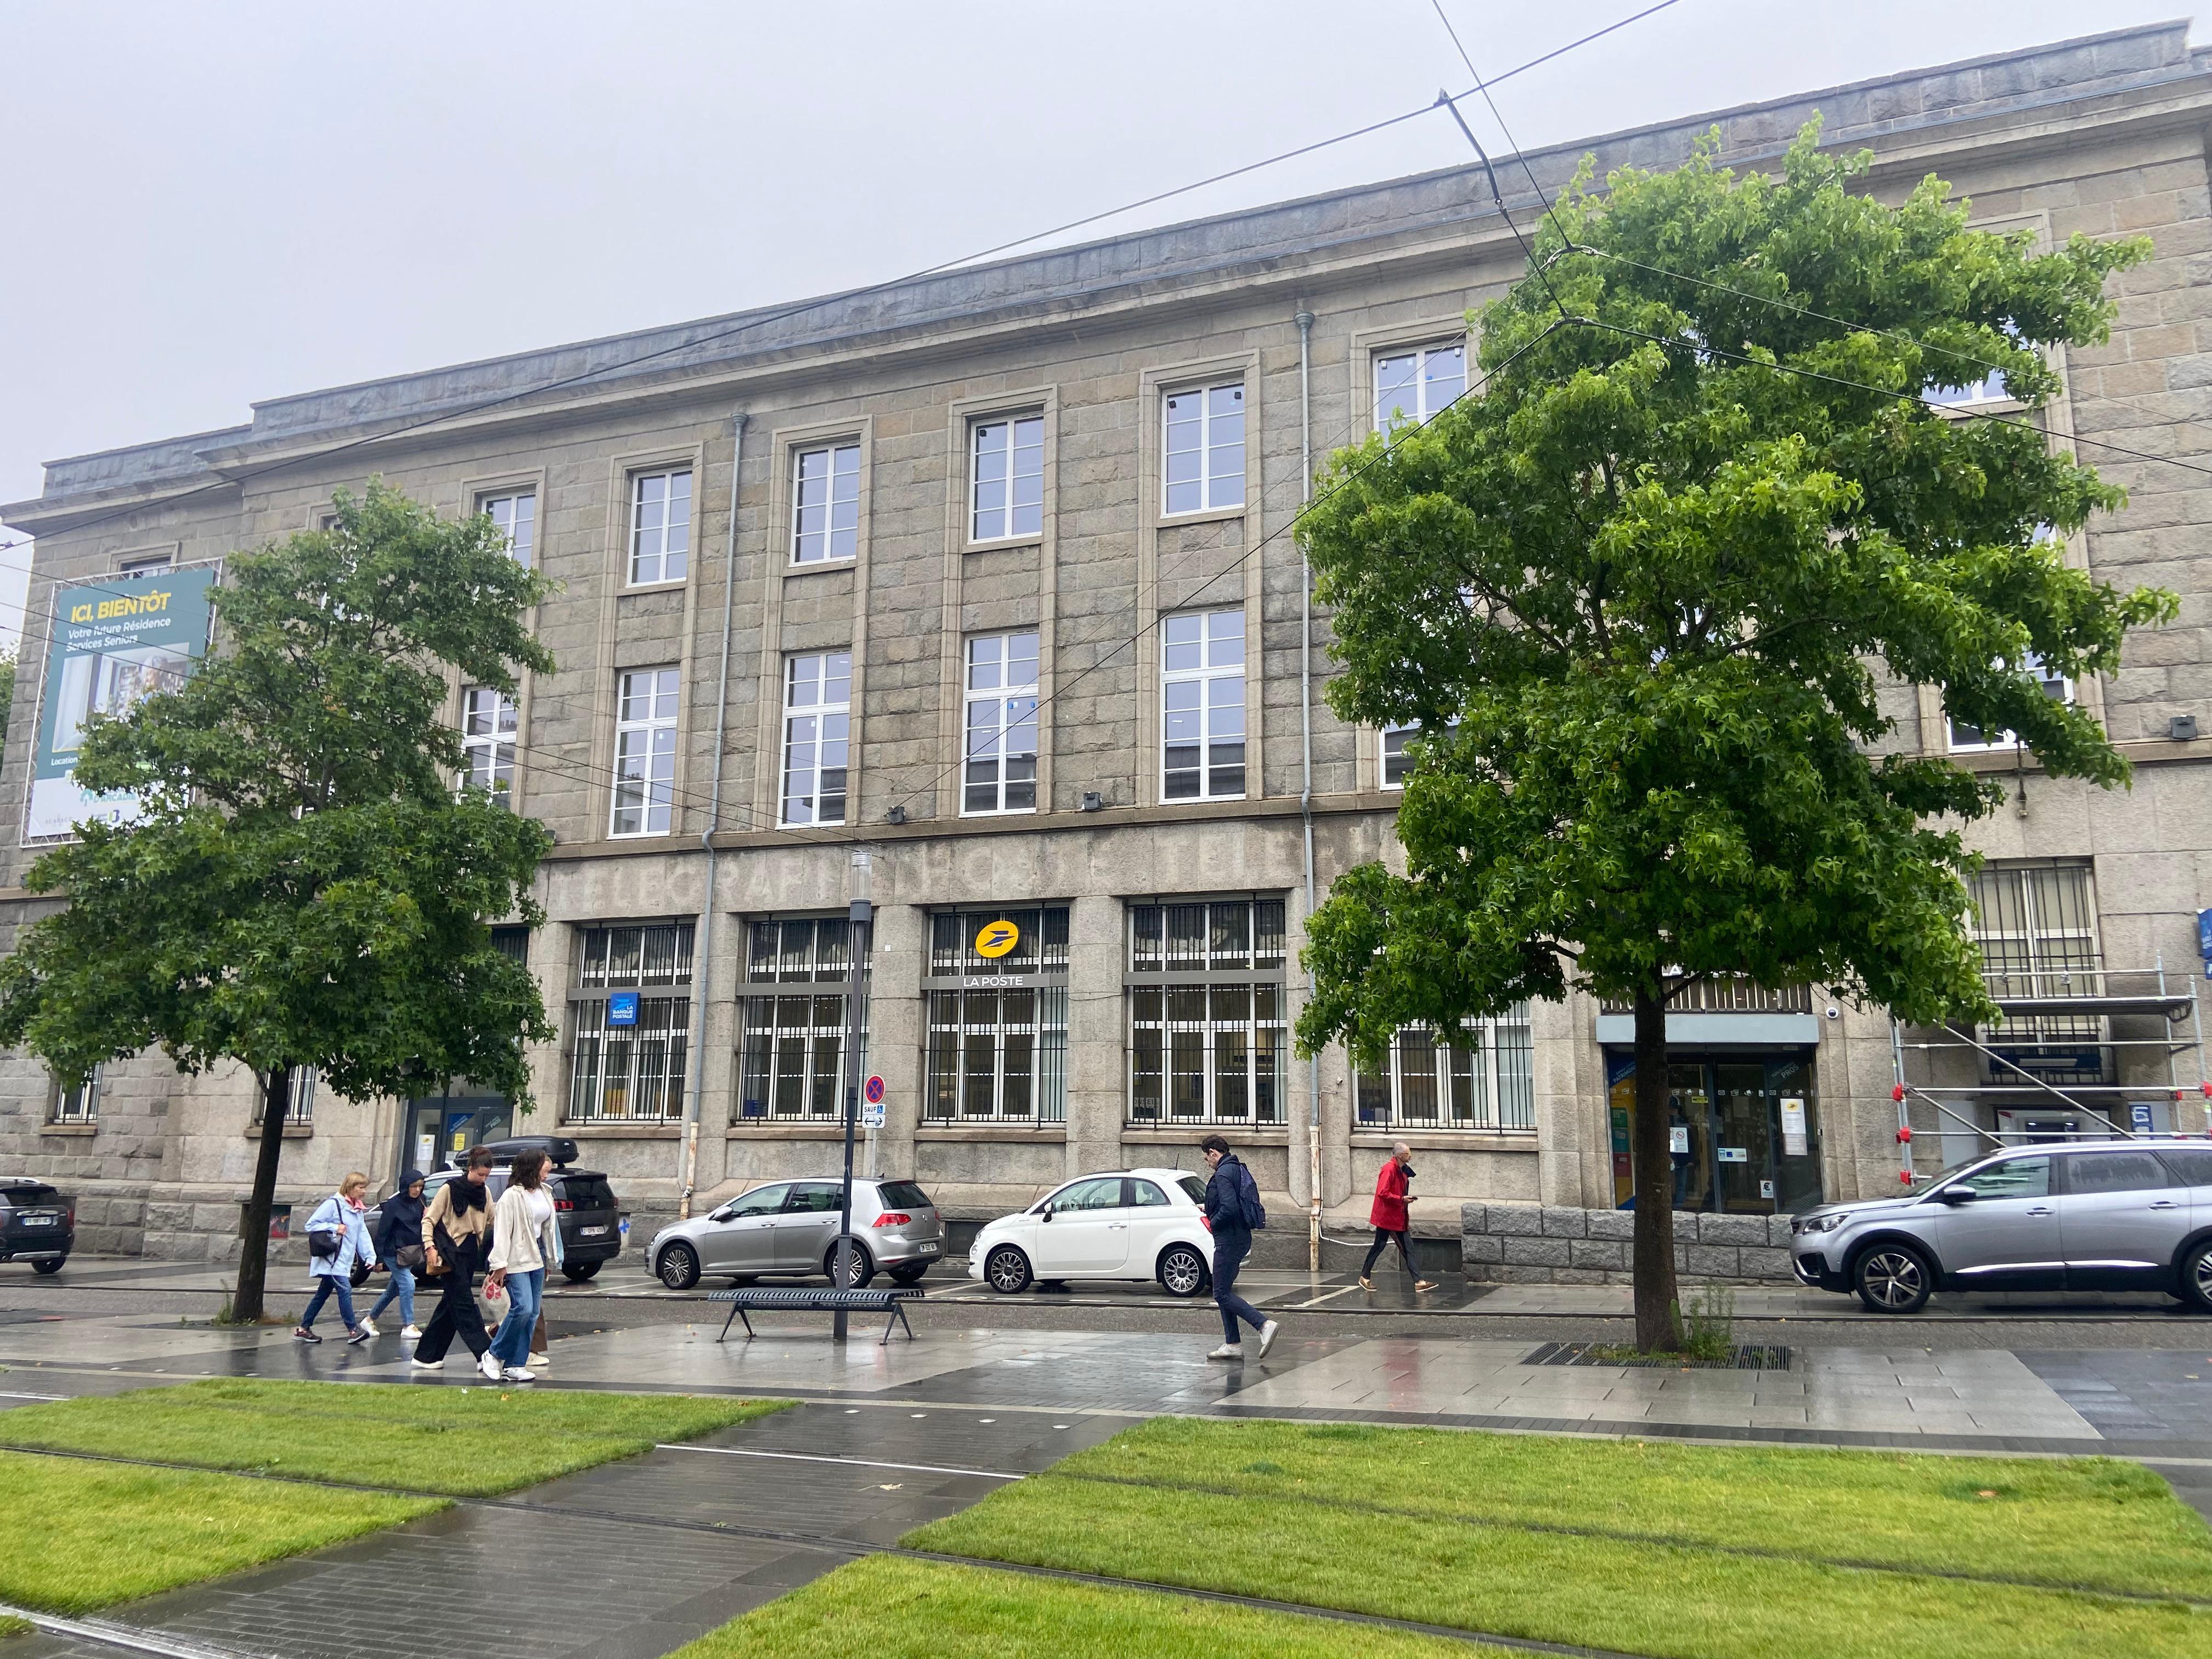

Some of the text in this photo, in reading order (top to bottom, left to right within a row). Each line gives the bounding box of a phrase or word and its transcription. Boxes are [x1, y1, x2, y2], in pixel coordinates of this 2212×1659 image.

[71, 589, 171, 624] ICI, BIENTÔT
[68, 618, 171, 640] Votre future Résidence
[66, 635, 138, 652] Services Seniors
[51, 756, 78, 766] Location
[963, 977, 1023, 987] LA POSTE
